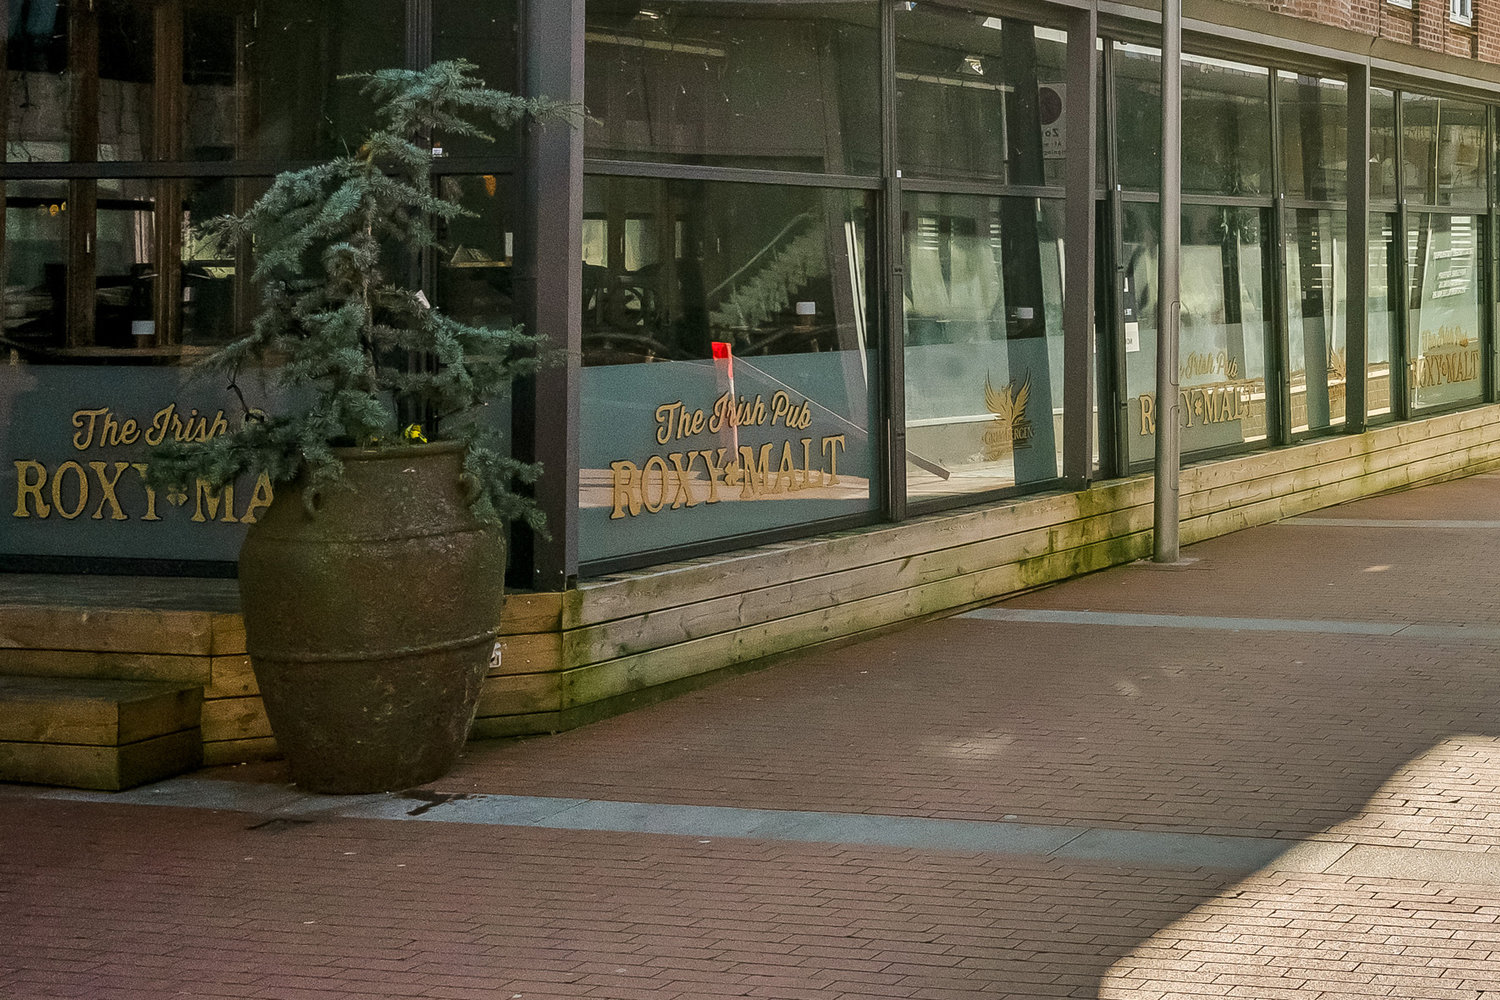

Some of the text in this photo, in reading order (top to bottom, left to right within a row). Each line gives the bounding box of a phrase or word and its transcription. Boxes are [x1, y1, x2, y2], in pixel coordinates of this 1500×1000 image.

[72, 407, 140, 450] The
[145, 403, 228, 446] Irish
[655, 390, 812, 445] The Irish Pub
[1201, 383, 1256, 425] MALT
[12, 459, 275, 523] ROXY MA
[609, 434, 846, 520] ROXY MALT
